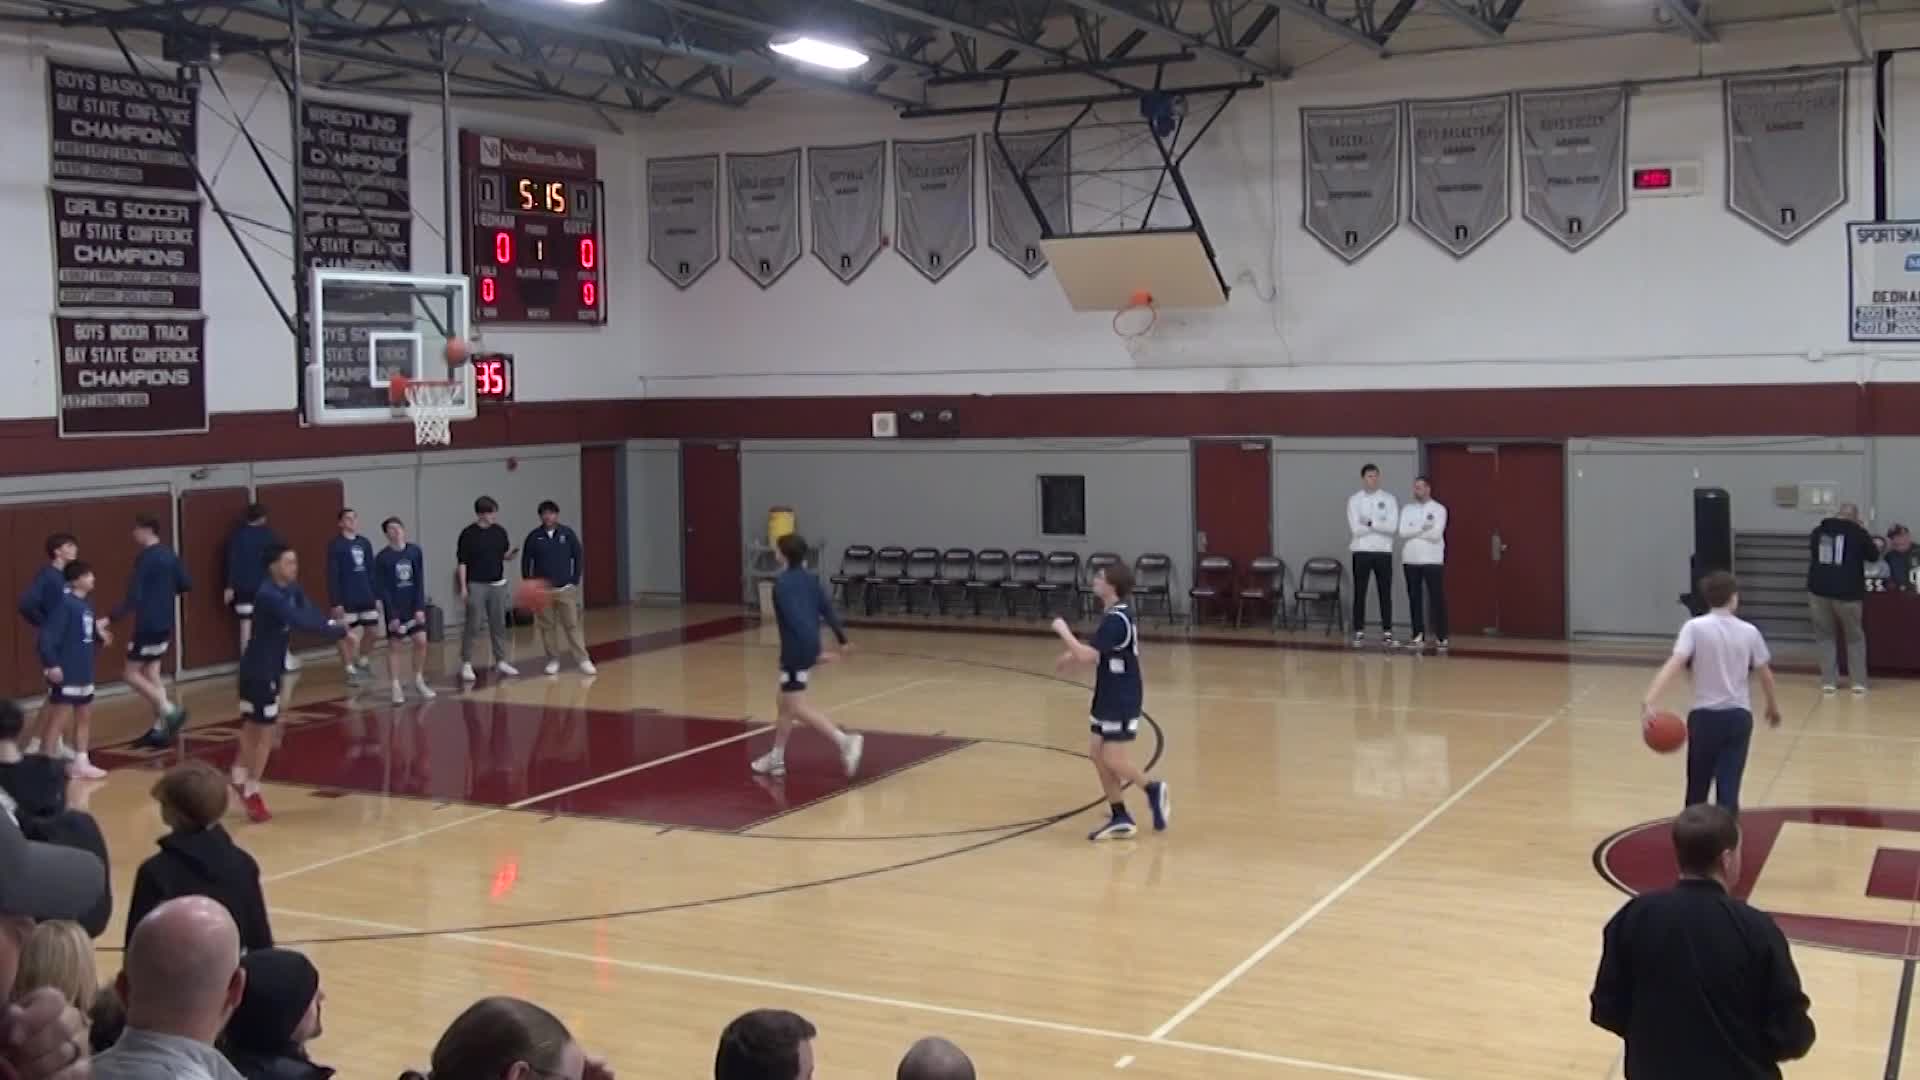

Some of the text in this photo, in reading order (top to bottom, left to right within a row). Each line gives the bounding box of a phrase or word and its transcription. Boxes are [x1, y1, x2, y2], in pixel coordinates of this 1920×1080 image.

[55, 69, 96, 90] BOYS
[82, 97, 120, 117] STATE
[519, 178, 565, 213] 5:15
[122, 202, 189, 222] SOCCER
[60, 220, 82, 238] BAY
[86, 223, 122, 240] STATE
[74, 245, 185, 266] CHAMPIONS
[496, 232, 510, 264] 0
[537, 239, 543, 260] 1
[580, 238, 594, 268] 0
[482, 278, 495, 302] 0
[583, 283, 595, 306] 0
[1873, 291, 1920, 303] DEDHA
[74, 324, 105, 341] BOYS
[154, 325, 189, 341] TRACK
[65, 347, 199, 363] BAY STATE CONFERENCE
[78, 369, 190, 387] CHAMPIONS
[477, 361, 503, 394] 35
